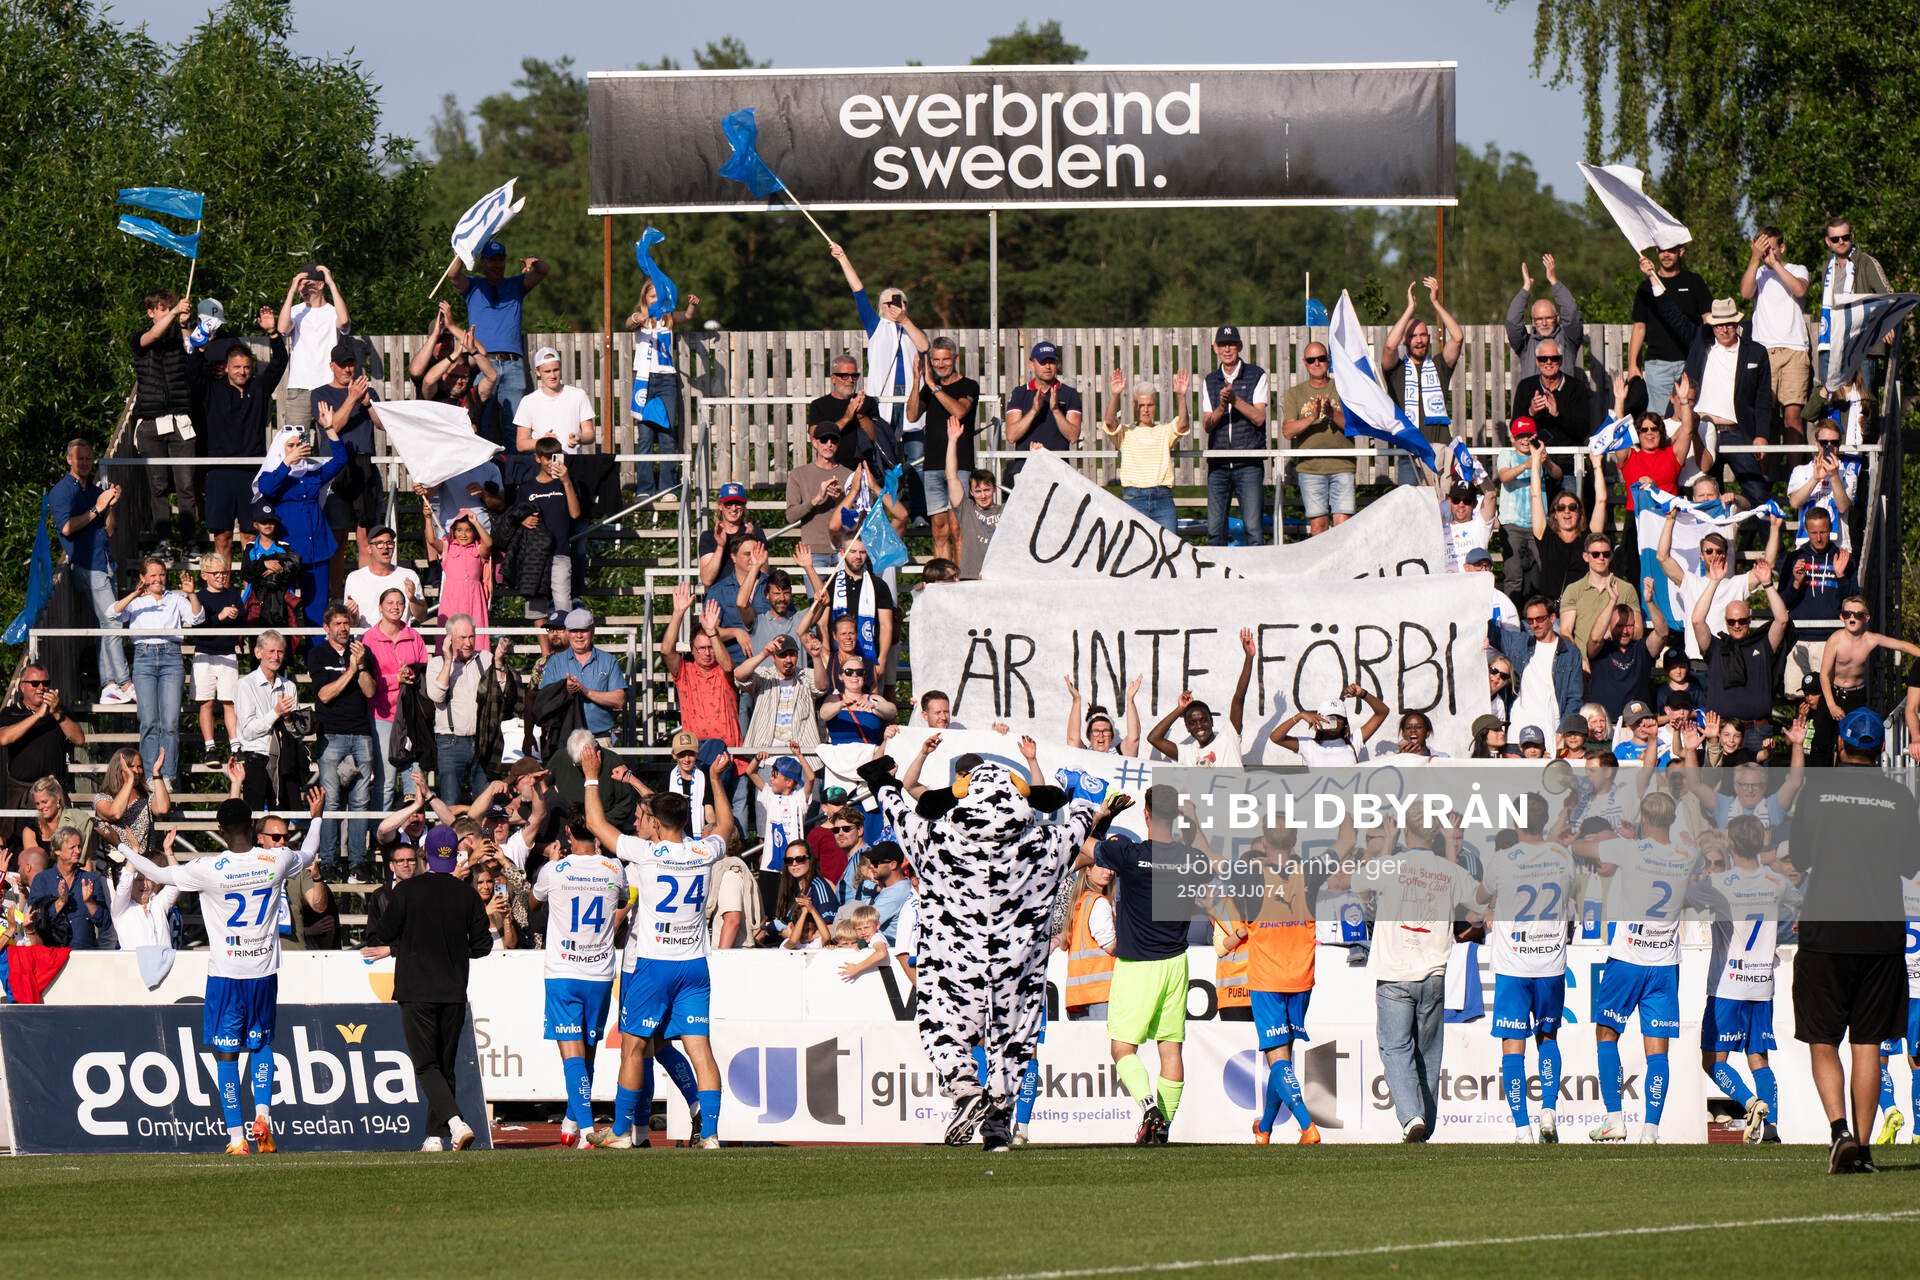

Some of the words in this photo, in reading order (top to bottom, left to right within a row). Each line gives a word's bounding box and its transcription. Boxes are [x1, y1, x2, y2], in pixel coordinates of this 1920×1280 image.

[839, 82, 1200, 138] everbrand
[872, 143, 1168, 191] sweden.
[211, 307, 218, 316] P
[952, 628, 1036, 719] ÄR
[1072, 627, 1222, 718] INTE
[1257, 621, 1458, 718] FÖRBI
[1819, 793, 1896, 810] ZINKTEKNIK
[1398, 875, 1427, 889] Coffee
[1419, 868, 1452, 883] Sunday
[224, 887, 273, 928] 27
[655, 875, 705, 914] 24
[1514, 882, 1562, 922] 22
[1645, 880, 1673, 918] 2
[570, 896, 606, 934] 14
[1745, 913, 1765, 951] 7
[728, 1037, 850, 1126] gt
[1021, 1072, 1036, 1096] office
[1509, 1078, 1521, 1103] office
[1649, 1075, 1663, 1099] office
[137, 1116, 233, 1142] Omtyckt
[292, 1116, 355, 1135] sedan
[360, 1115, 411, 1135] 1949
[1071, 1107, 1132, 1124] specialist
[1443, 1113, 1472, 1127] your
[1476, 1112, 1502, 1125] zinc
